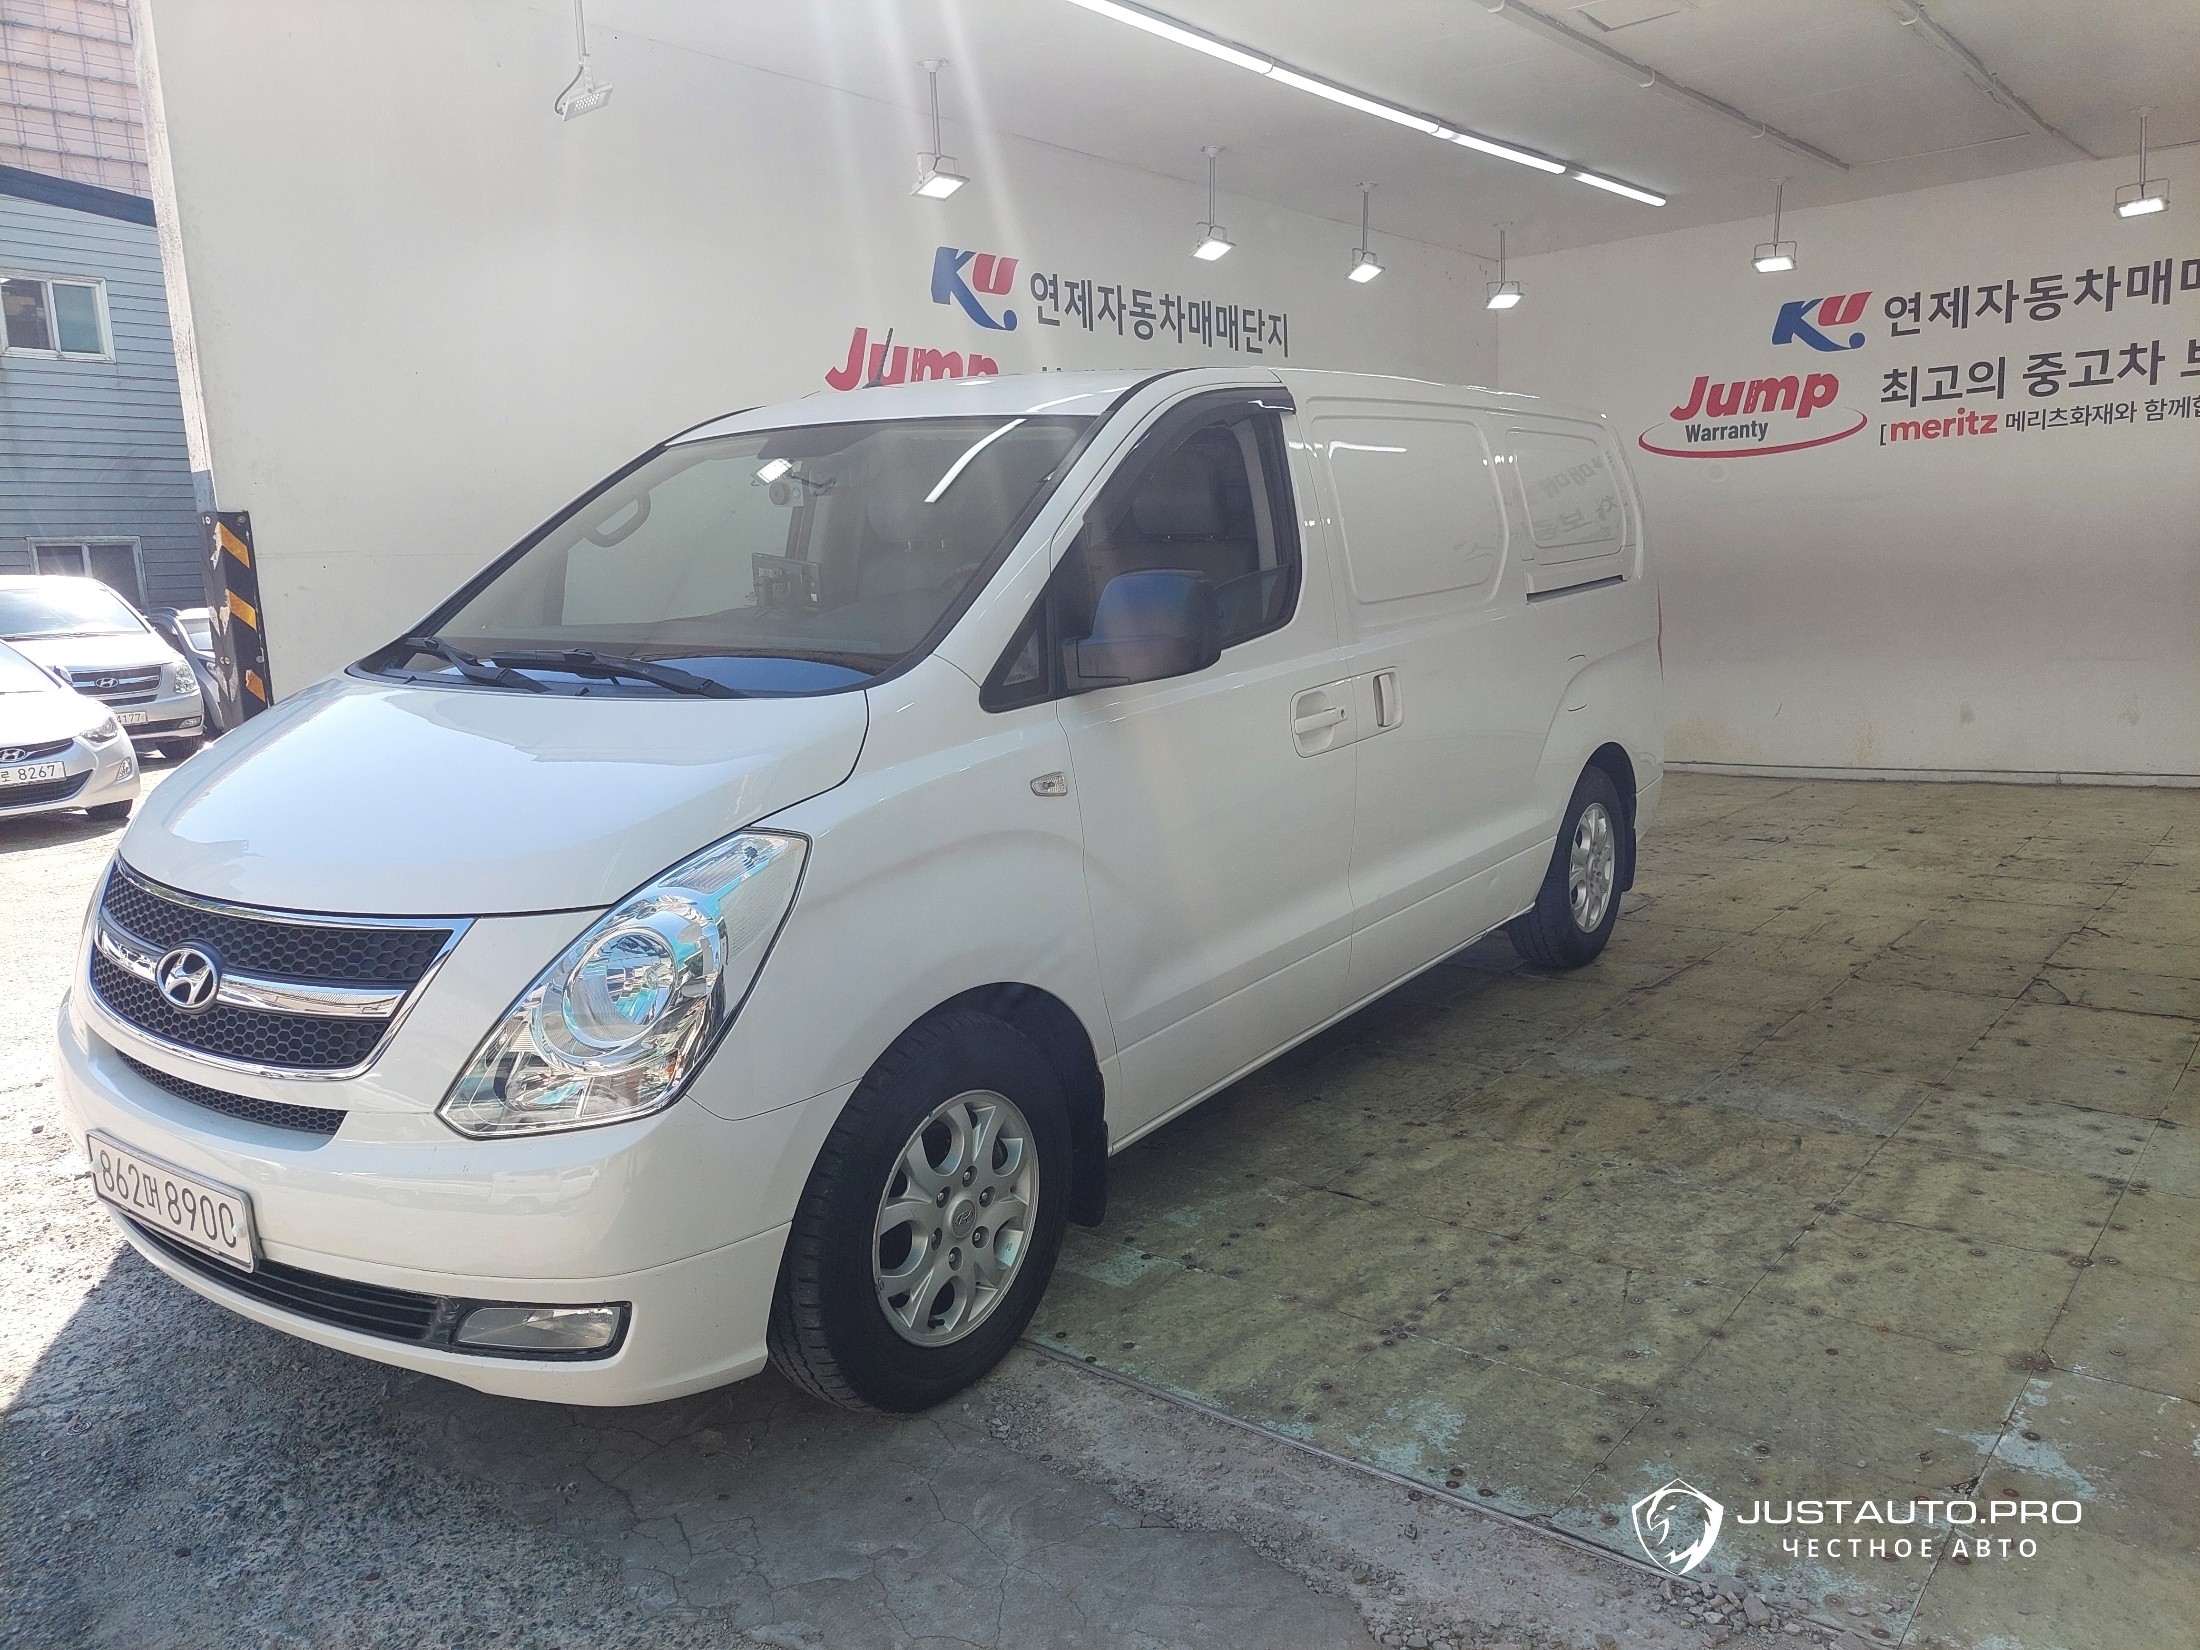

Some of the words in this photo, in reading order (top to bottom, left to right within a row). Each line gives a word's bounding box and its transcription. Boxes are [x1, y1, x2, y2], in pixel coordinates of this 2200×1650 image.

[1029, 271, 1290, 358] 연제자동차매매단지
[1880, 356, 2006, 408] 최고의
[2022, 339, 2166, 397] 중고차
[1670, 373, 1839, 420] Jump
[2005, 400, 2138, 432] 메리츠화재와
[1685, 420, 1769, 443] Warranty
[18, 765, 55, 780] 8267
